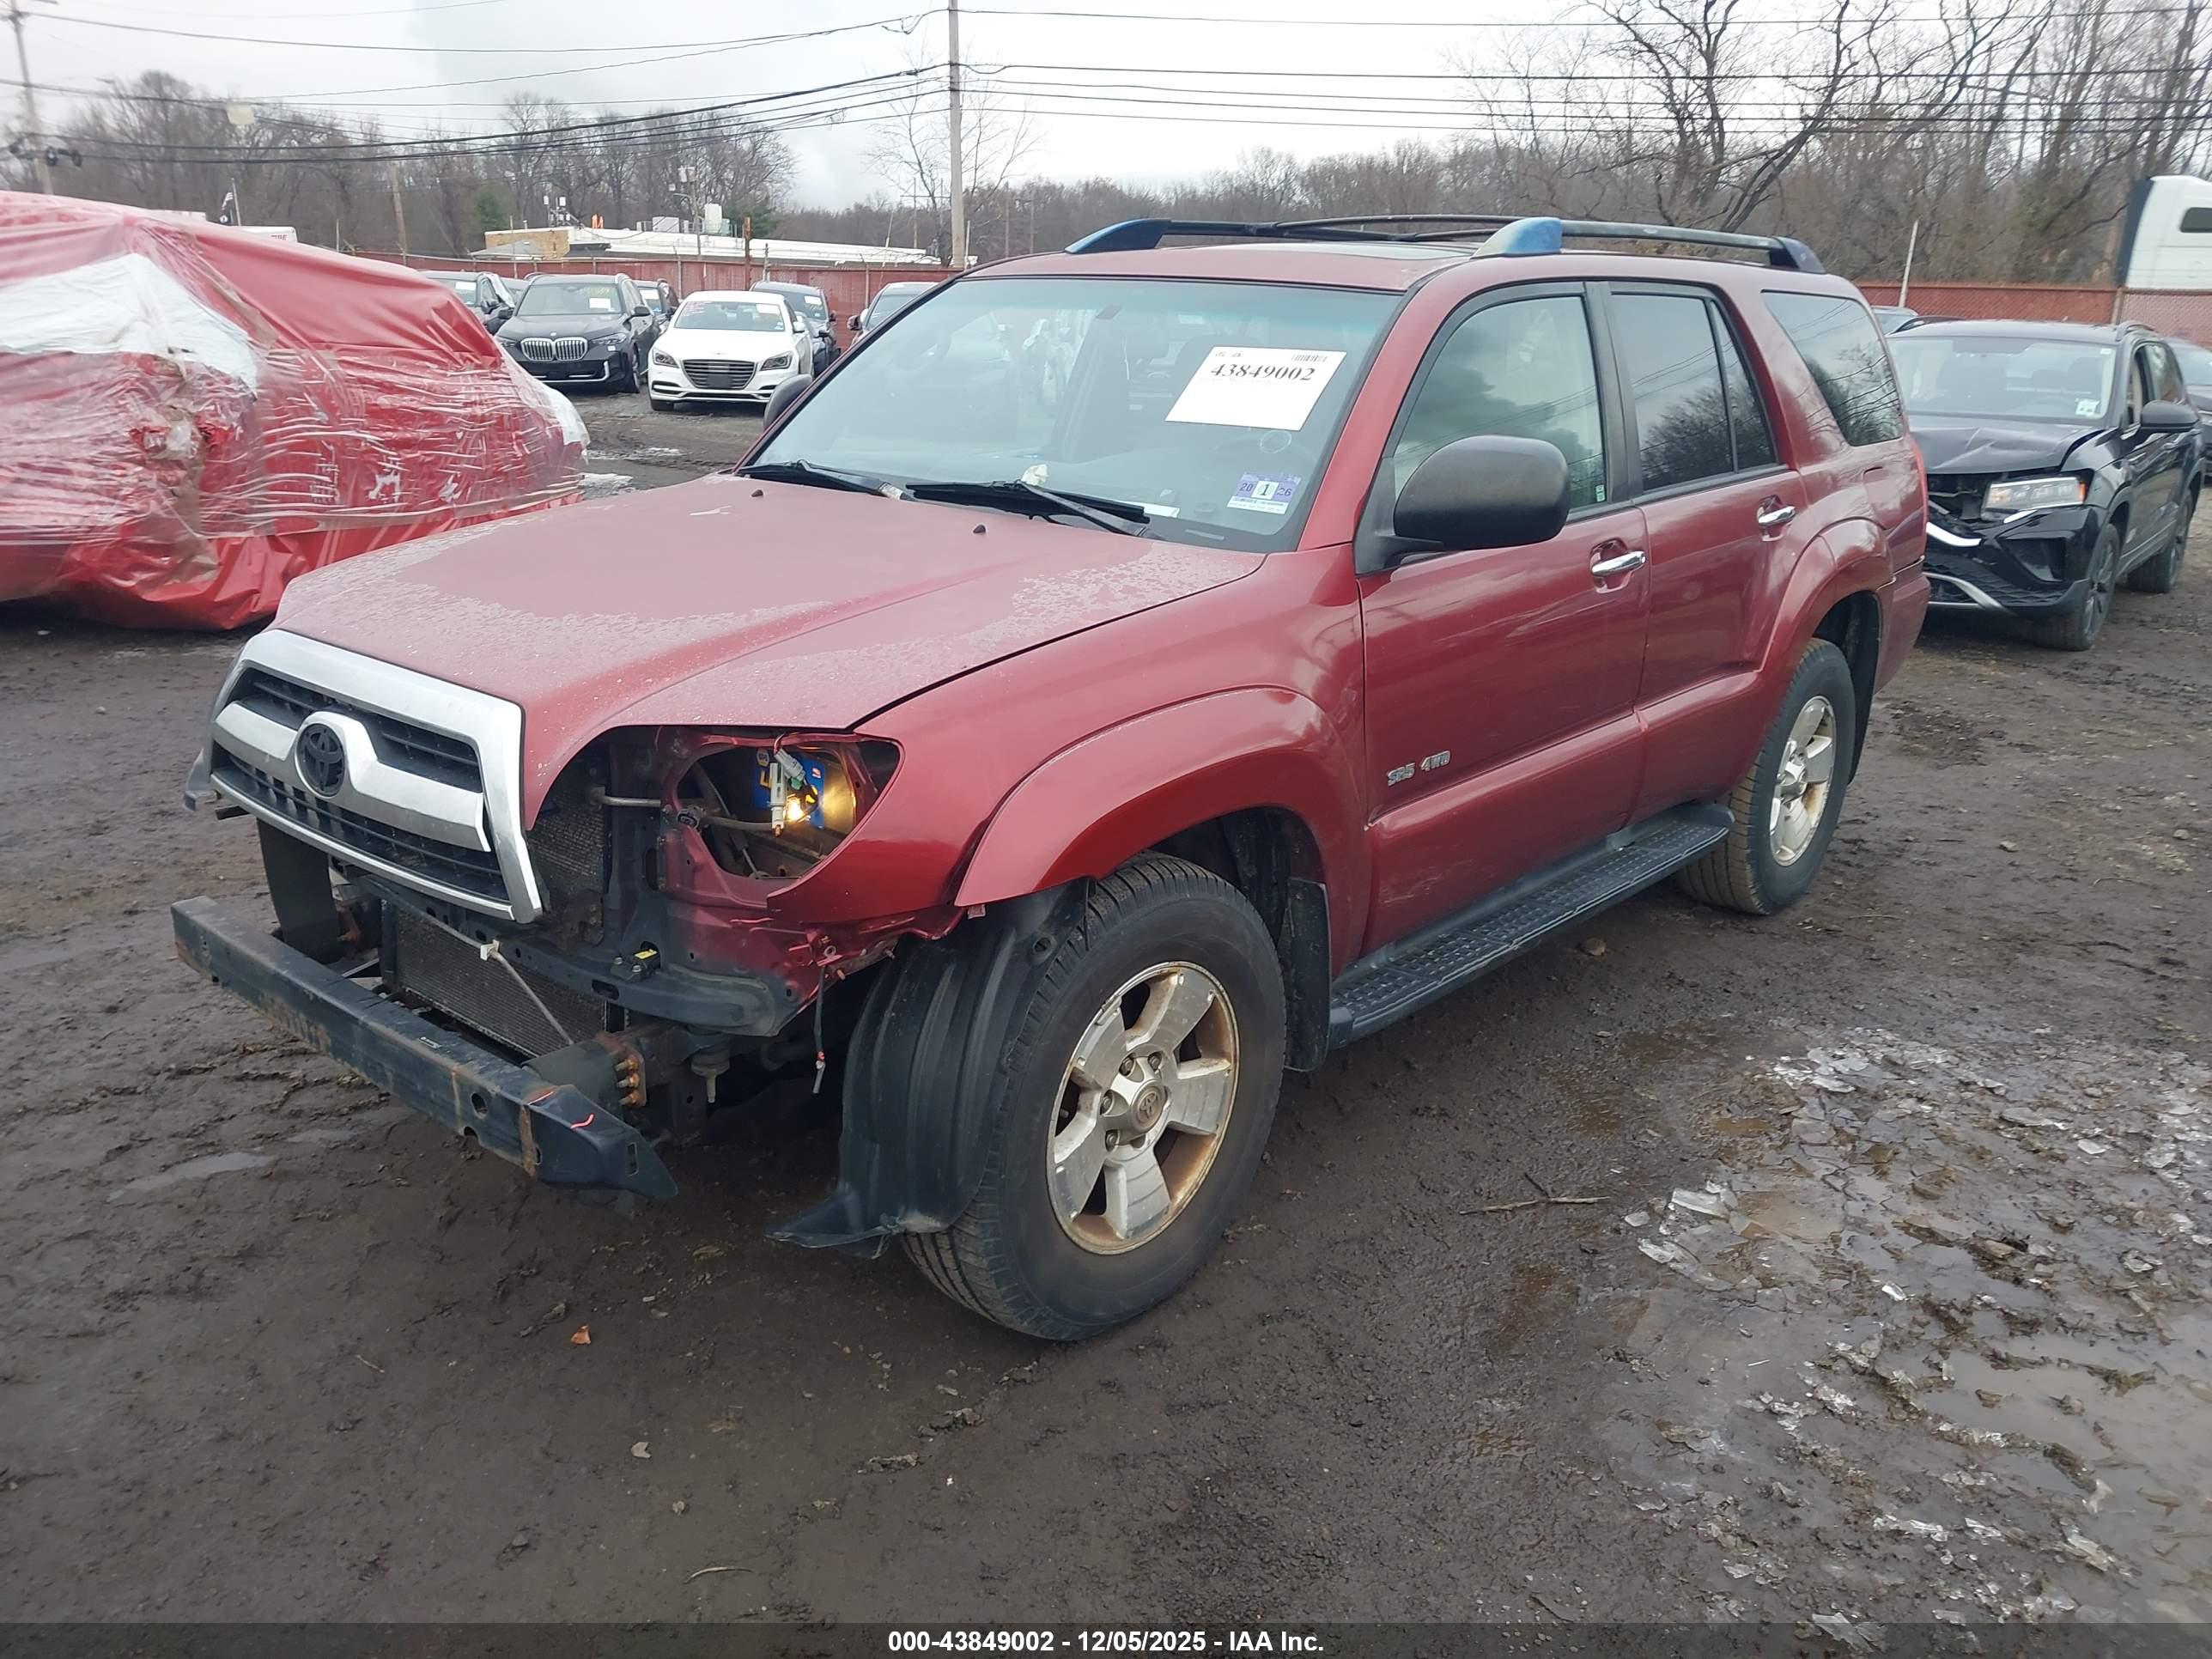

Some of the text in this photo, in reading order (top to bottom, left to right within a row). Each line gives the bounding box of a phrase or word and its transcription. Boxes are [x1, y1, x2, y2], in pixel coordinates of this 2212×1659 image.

[1211, 363, 1316, 381] 43849002
[1239, 483, 1254, 492] 20
[1260, 483, 1271, 496] 1
